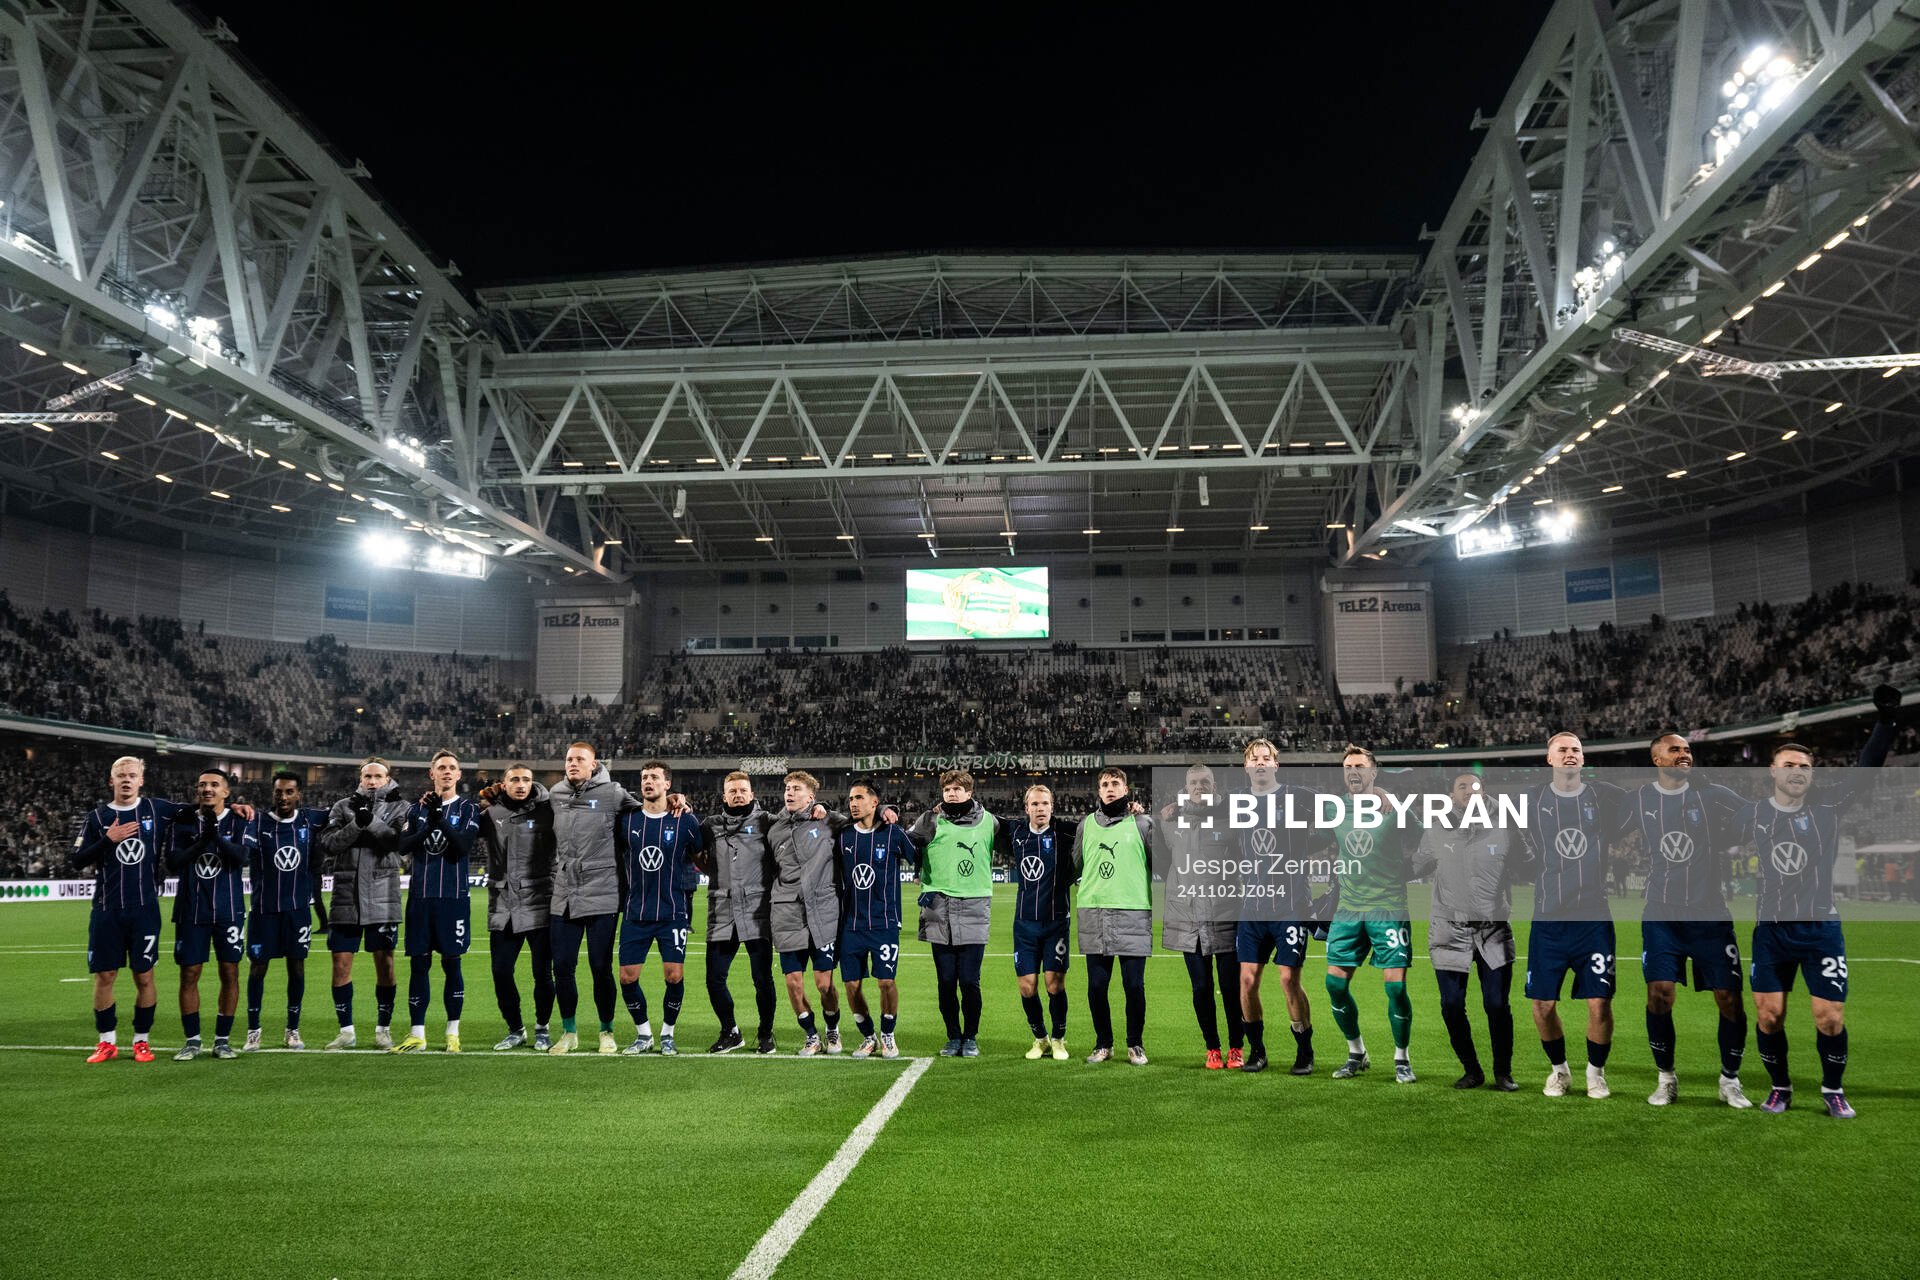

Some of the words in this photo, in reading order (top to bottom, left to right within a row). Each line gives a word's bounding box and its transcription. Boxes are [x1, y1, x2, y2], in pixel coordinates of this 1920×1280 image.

[1338, 597, 1378, 612] TELE2
[1382, 600, 1421, 612] Arena
[543, 613, 580, 627] TELE2
[583, 616, 620, 627] Arena
[59, 884, 96, 897] UNIBE
[455, 919, 465, 937] 5
[672, 928, 687, 946] 19
[143, 935, 156, 954] 7
[1055, 937, 1067, 955] 6
[1385, 927, 1409, 948] 30
[879, 943, 899, 962] 37
[1725, 944, 1738, 965] 9
[1821, 956, 1848, 979] 25
